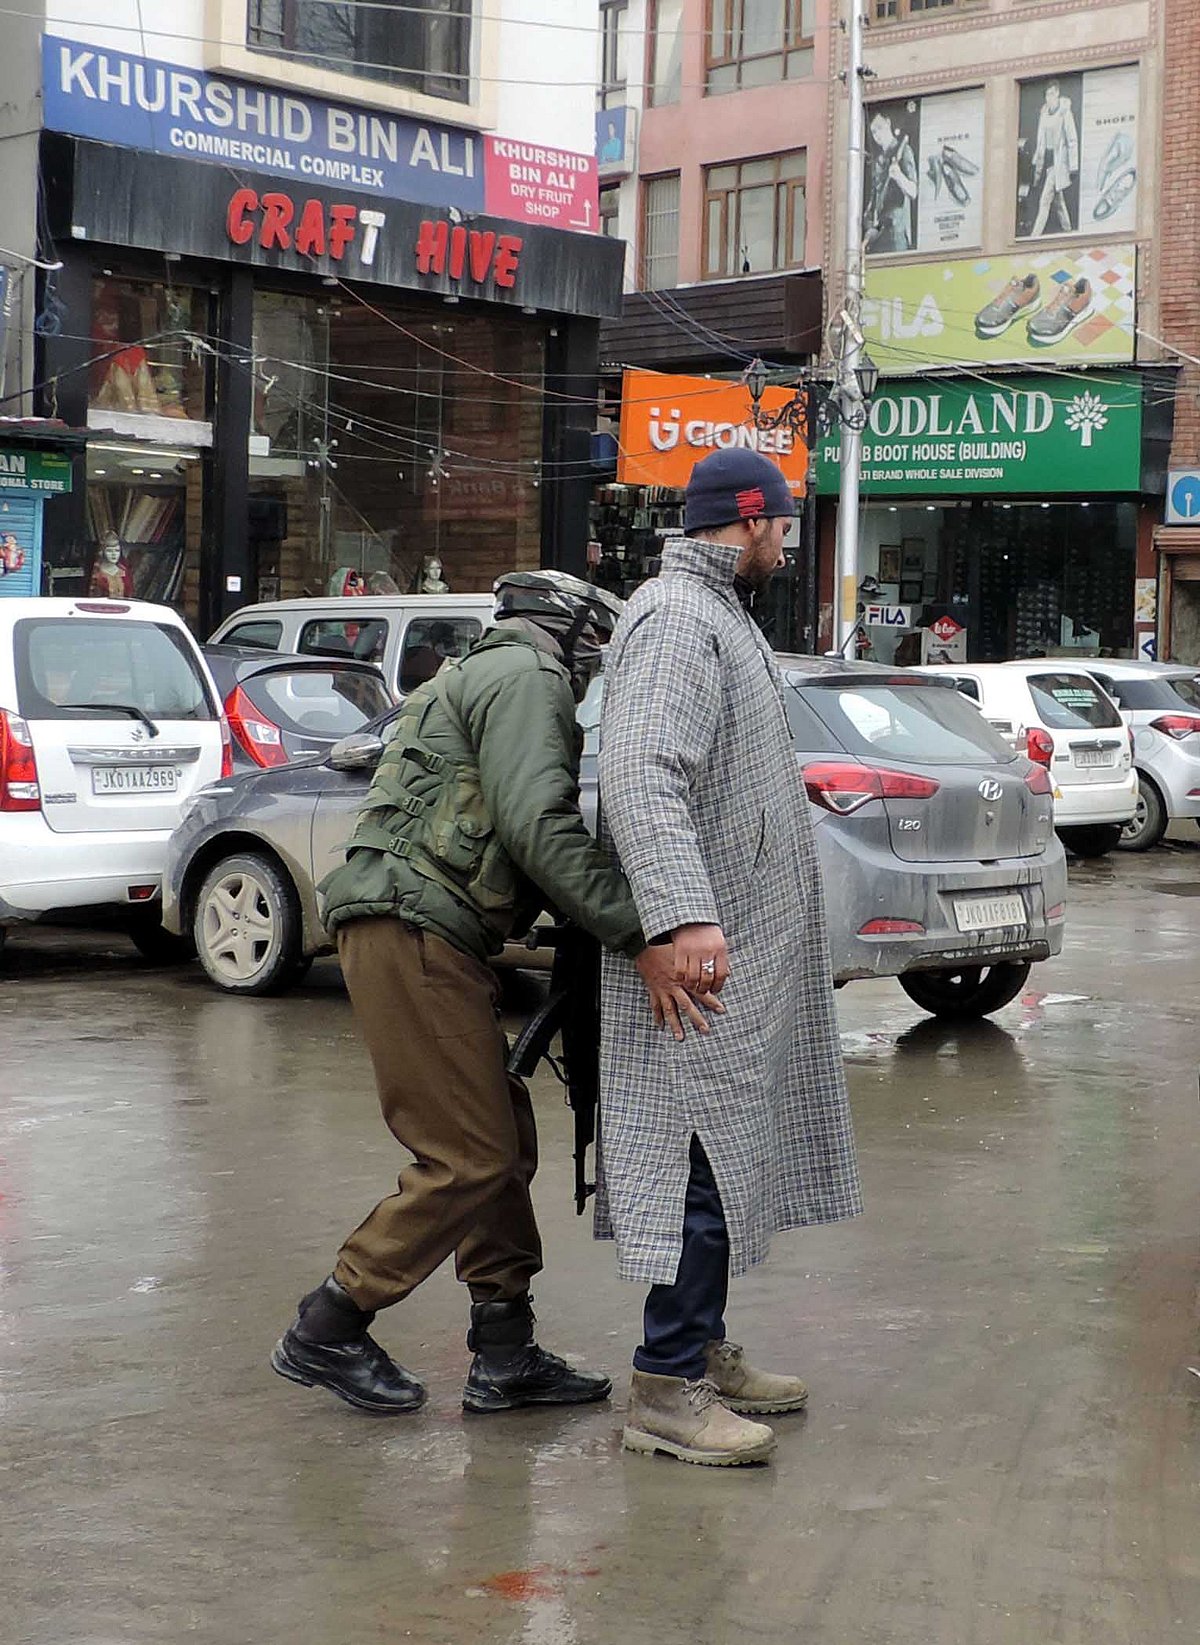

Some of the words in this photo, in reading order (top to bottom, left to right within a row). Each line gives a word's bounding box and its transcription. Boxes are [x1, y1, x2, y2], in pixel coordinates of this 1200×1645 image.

[60, 47, 312, 143] KHURSHID
[327, 106, 398, 163] BIN
[409, 126, 475, 178] ALI
[170, 128, 296, 170] COMMERCIAL
[300, 154, 385, 189] COMPLEX
[494, 140, 590, 173] KHURSHID
[509, 164, 543, 184] BIN
[546, 171, 577, 190] ALI
[511, 183, 536, 198] DRY
[538, 186, 574, 206] FRUIT
[525, 201, 561, 217] SHOP
[226, 188, 386, 266] CRAFT
[416, 219, 523, 288] HIVE
[685, 420, 794, 455] GIONEE
[874, 444, 910, 462] BOOT
[912, 442, 955, 461] HOUSE
[959, 440, 1027, 462] (BUILDING)
[872, 469, 904, 480] BRAND
[905, 468, 938, 480] WHOLE
[939, 468, 963, 480] SALE
[964, 467, 1004, 479] DIVISION
[31, 479, 65, 491] STORE
[869, 607, 906, 625] FILA
[103, 771, 174, 789] JK01AA2969
[898, 819, 922, 831] i20
